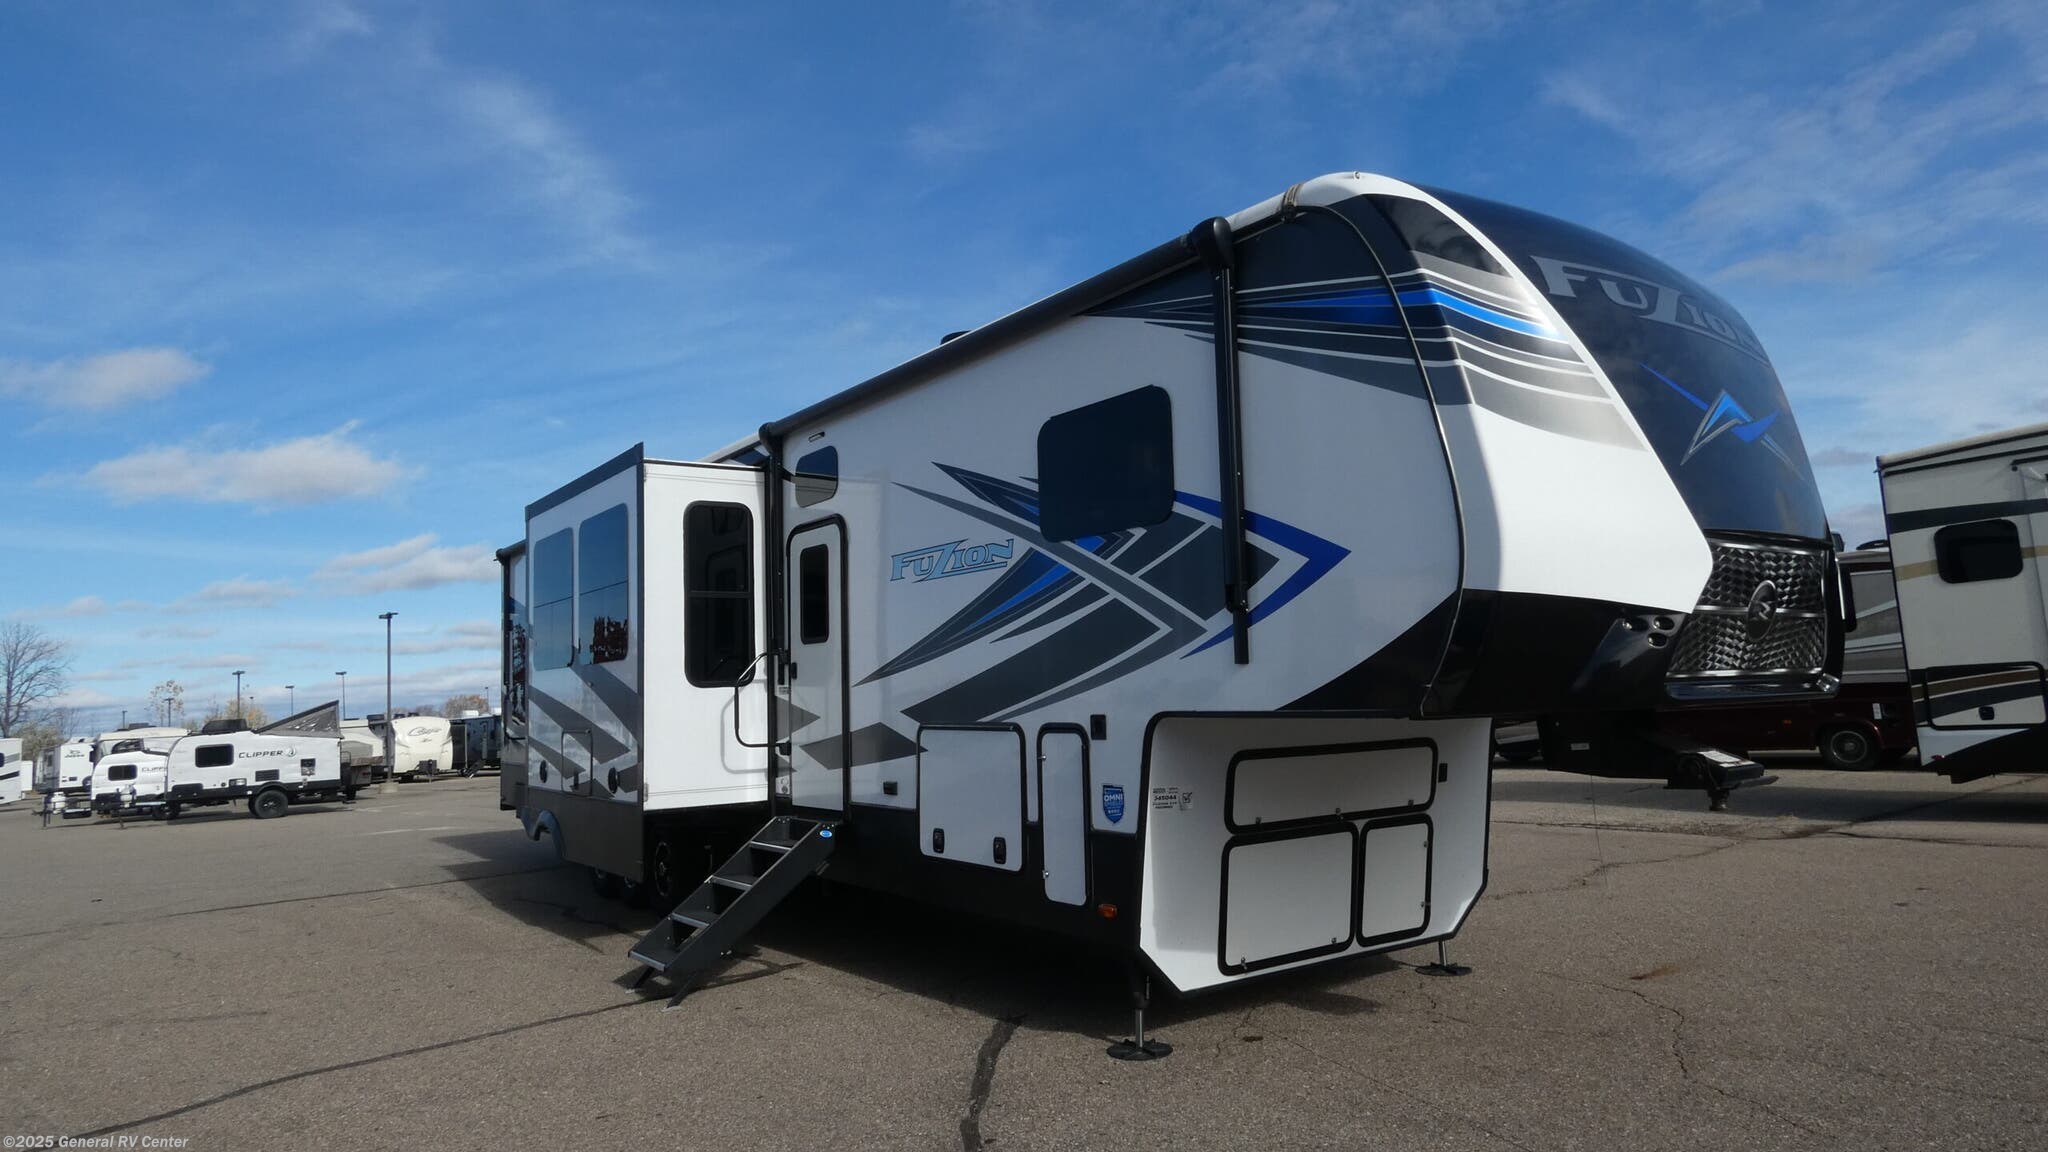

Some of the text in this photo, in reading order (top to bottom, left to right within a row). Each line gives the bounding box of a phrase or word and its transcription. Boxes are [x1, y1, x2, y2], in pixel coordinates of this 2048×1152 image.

[890, 538, 1014, 583] FUZION
[238, 750, 283, 759] CLIPPER
[1104, 793, 1123, 802] OMNI
